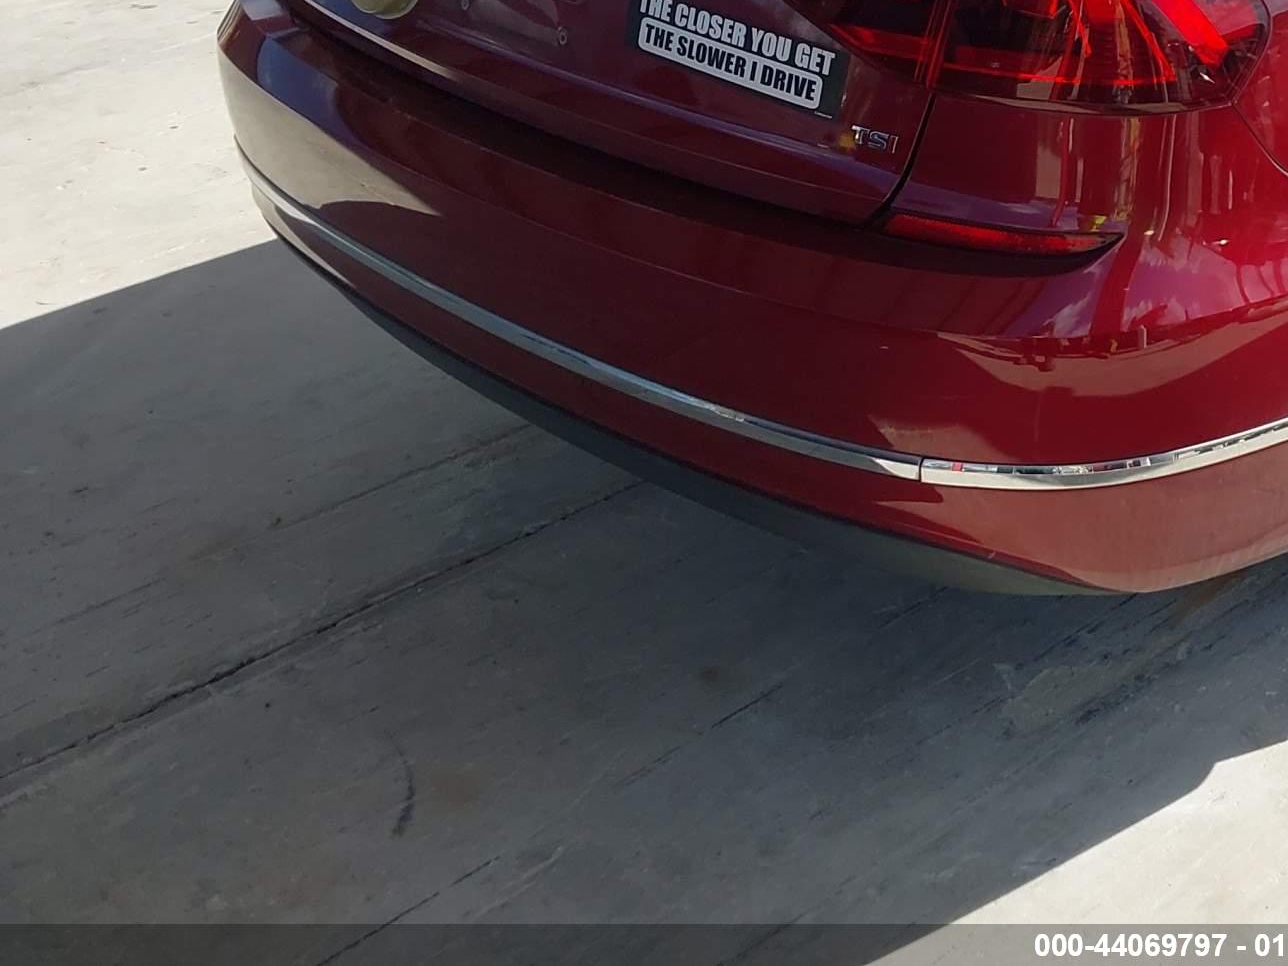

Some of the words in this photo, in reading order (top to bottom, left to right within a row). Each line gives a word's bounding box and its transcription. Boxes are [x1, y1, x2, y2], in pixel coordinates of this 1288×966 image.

[644, 23, 673, 52] THE
[676, 34, 747, 78] SLOWER
[749, 60, 757, 81] I
[760, 65, 817, 102] DRIVE
[674, 2, 748, 48] CLOSER
[750, 27, 792, 62] YOU
[795, 42, 836, 76] GET
[851, 125, 899, 154] TSI
